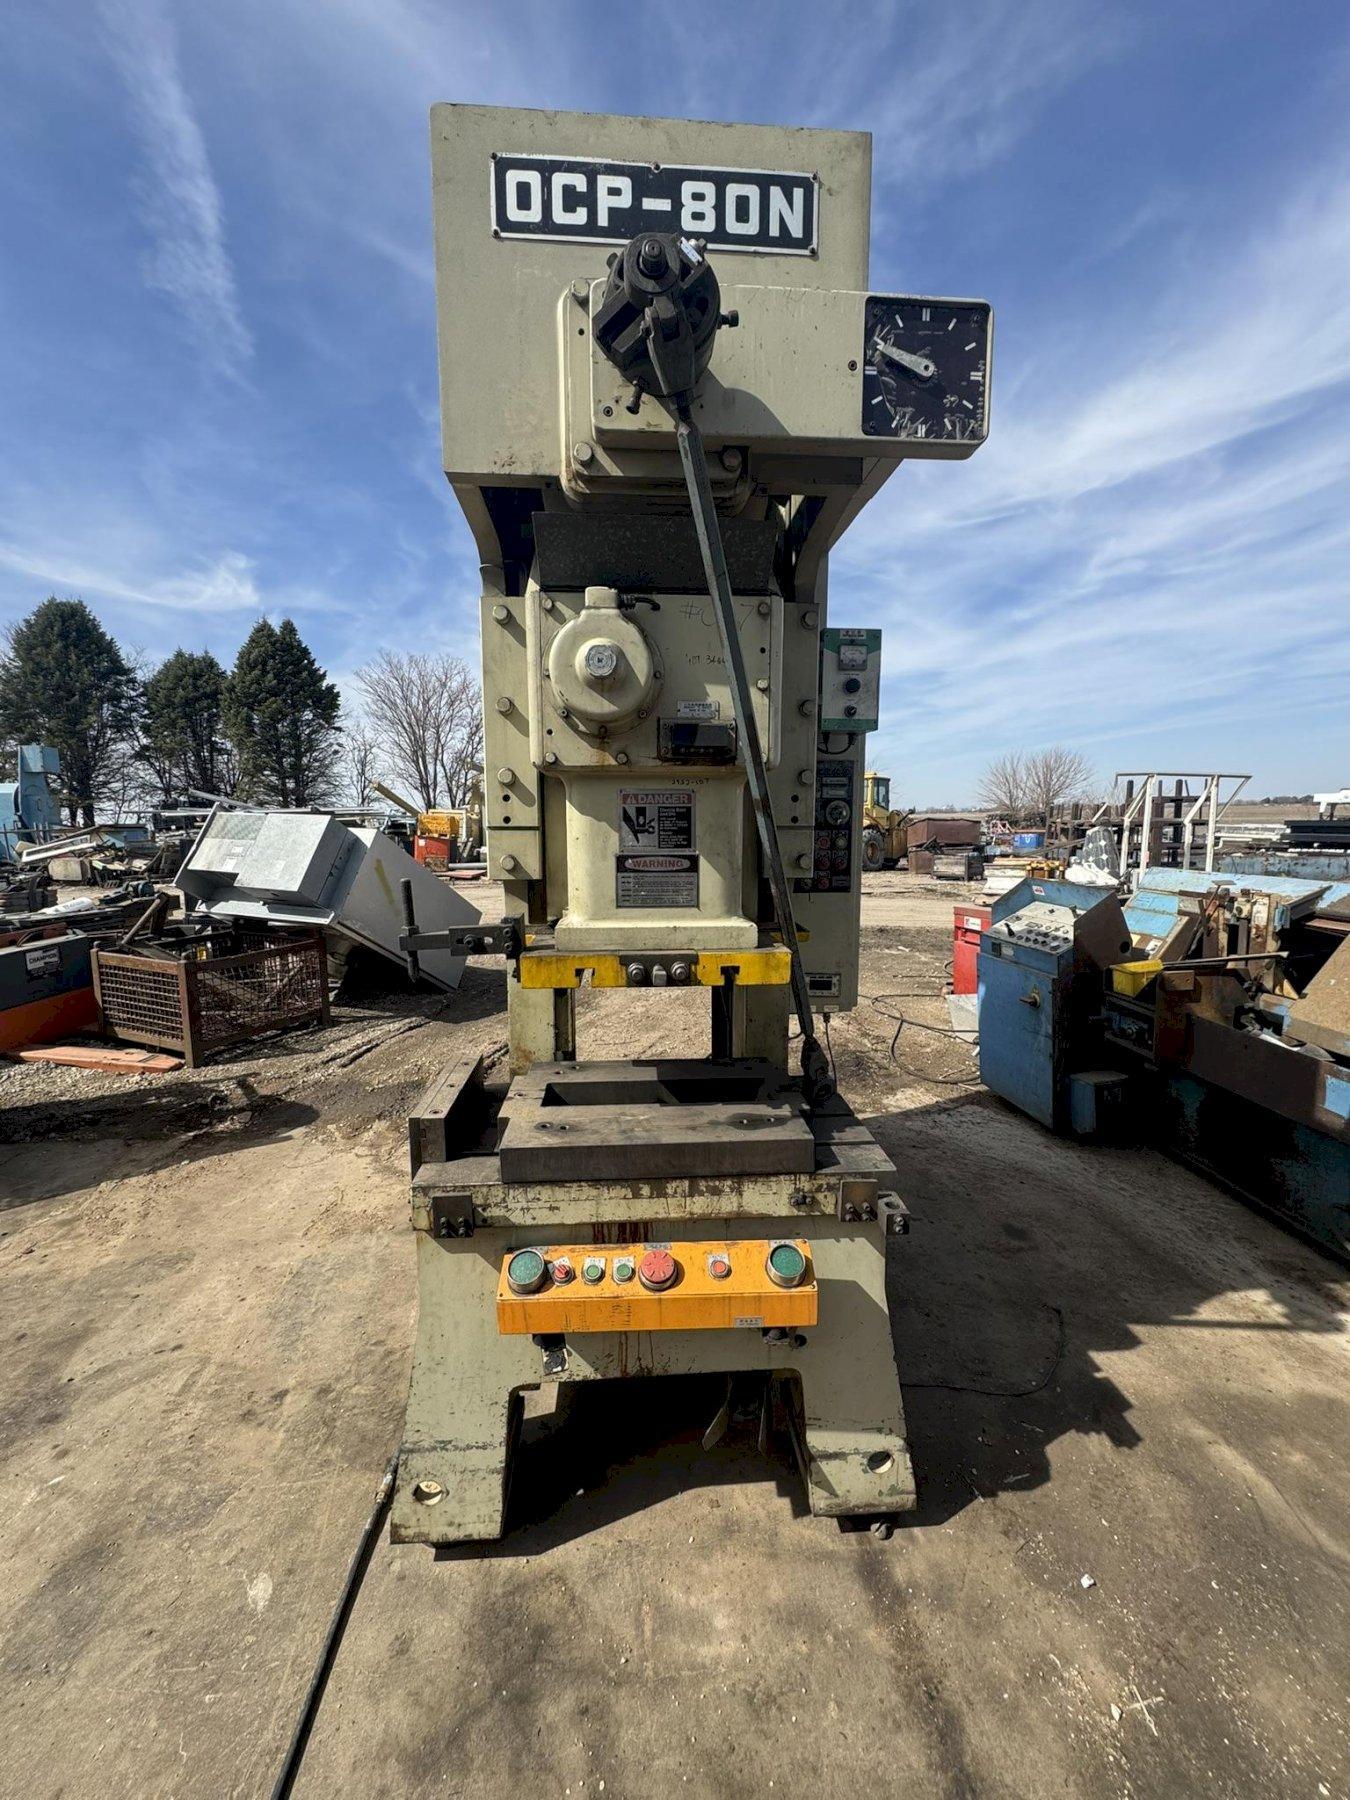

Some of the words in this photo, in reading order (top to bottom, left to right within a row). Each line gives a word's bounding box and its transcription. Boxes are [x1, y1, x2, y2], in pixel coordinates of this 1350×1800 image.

[505, 169, 804, 238] OCP-80N
[638, 794, 688, 804] DANGER
[633, 860, 684, 869] WARNING
